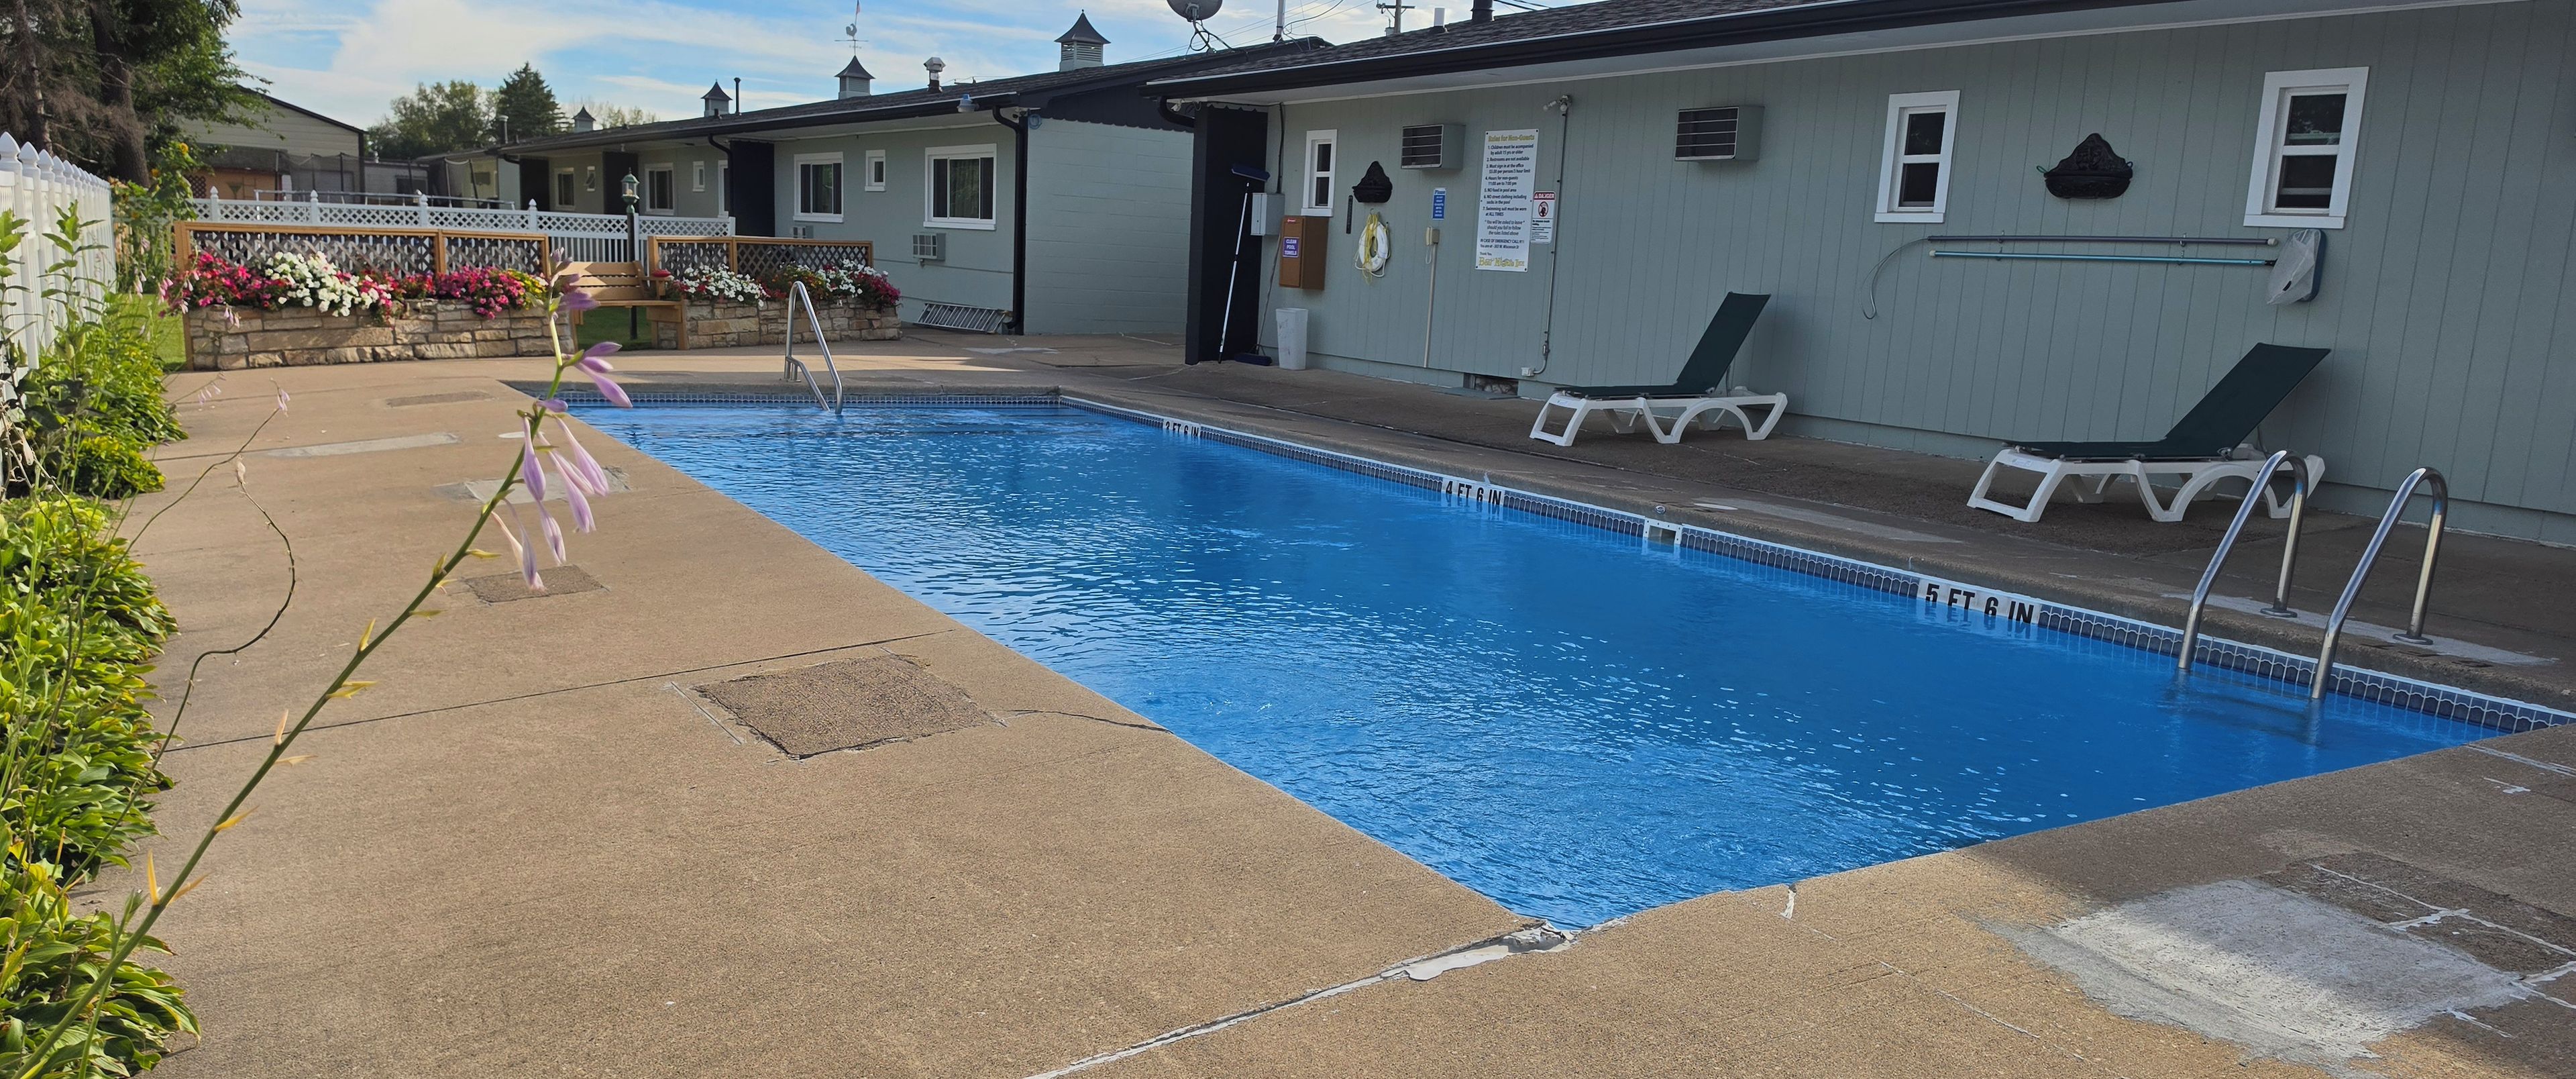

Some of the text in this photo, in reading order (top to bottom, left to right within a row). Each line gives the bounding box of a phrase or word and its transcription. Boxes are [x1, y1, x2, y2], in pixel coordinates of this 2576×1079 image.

[1172, 423, 1181, 433] FT
[1184, 425, 1189, 434] 6
[1191, 425, 1199, 436] IN
[1446, 480, 1502, 505] 4 FT 6 IN
[1925, 583, 2035, 624] 5 FT 6 IN
